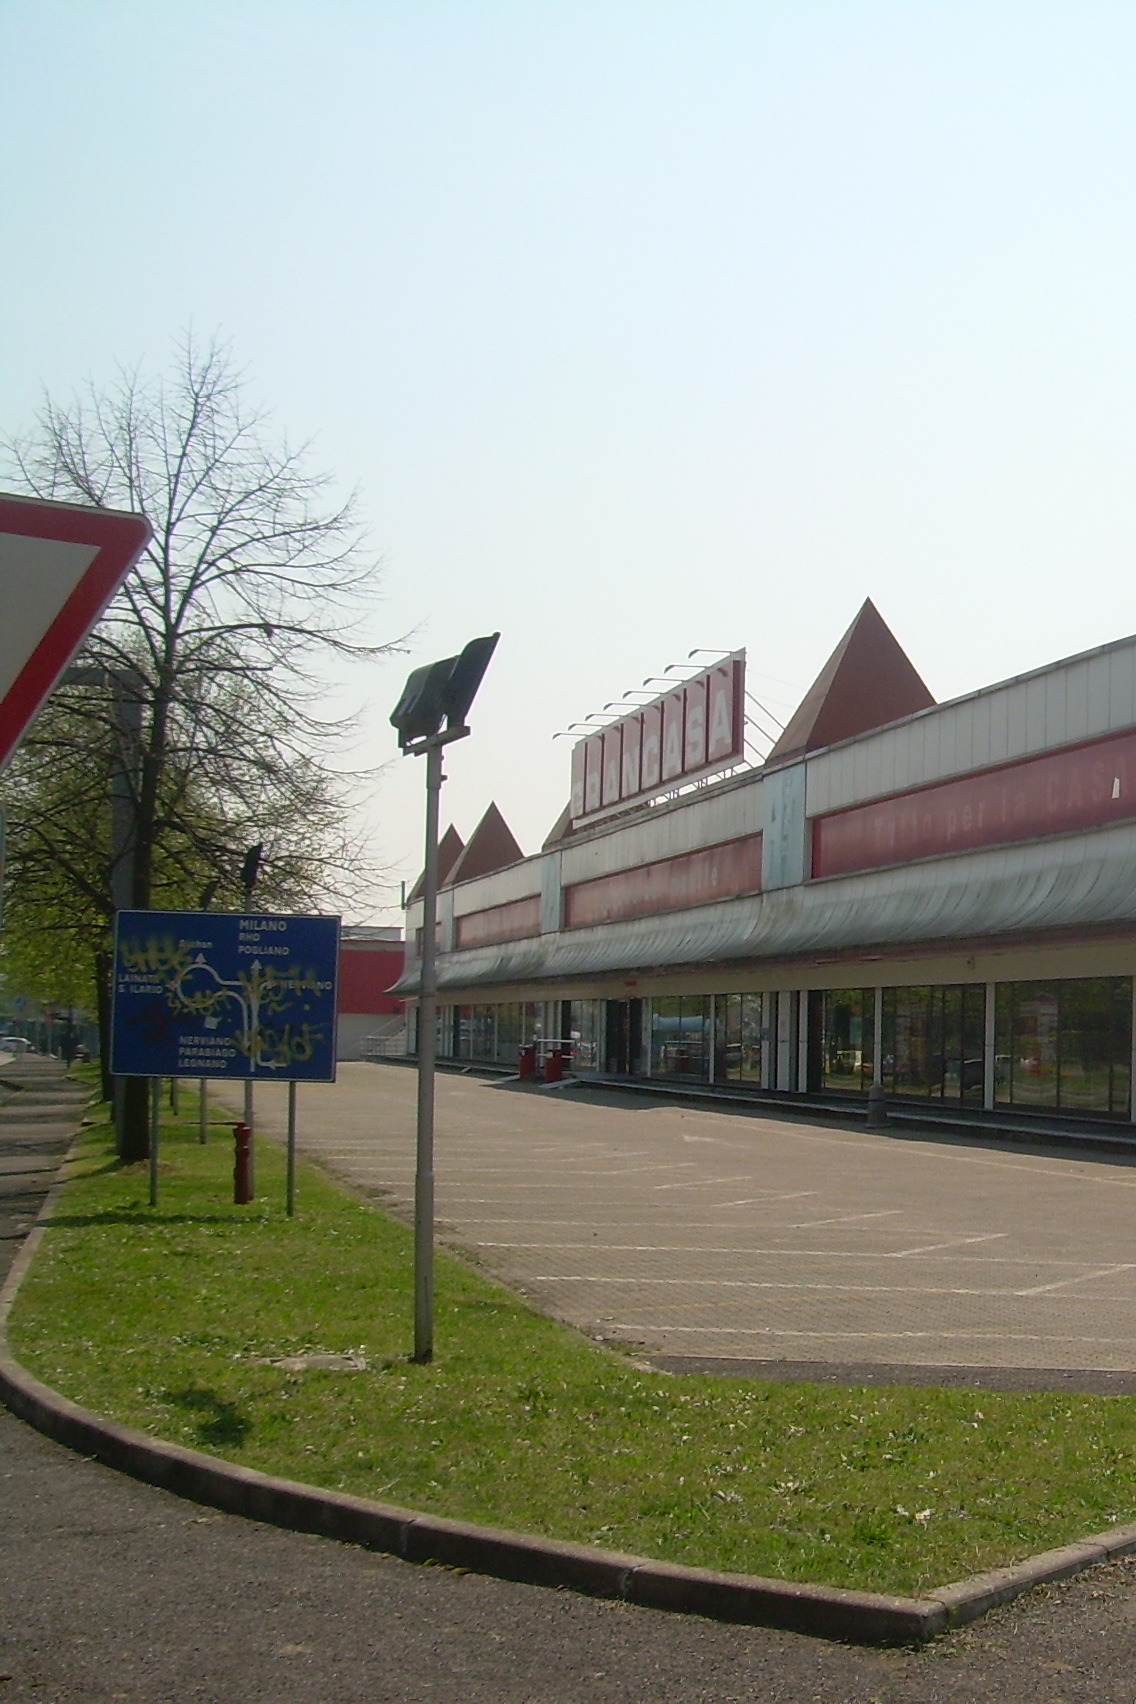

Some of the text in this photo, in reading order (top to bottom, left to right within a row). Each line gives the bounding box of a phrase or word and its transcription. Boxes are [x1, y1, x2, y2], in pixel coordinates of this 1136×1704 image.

[239, 919, 287, 932] MILANO
[238, 932, 260, 942] RHO
[238, 945, 290, 956] POGLIANO
[130, 984, 163, 994] ILARIO
[178, 1046, 237, 1058] PARABIAGO
[178, 1058, 227, 1069] LEGNANO
